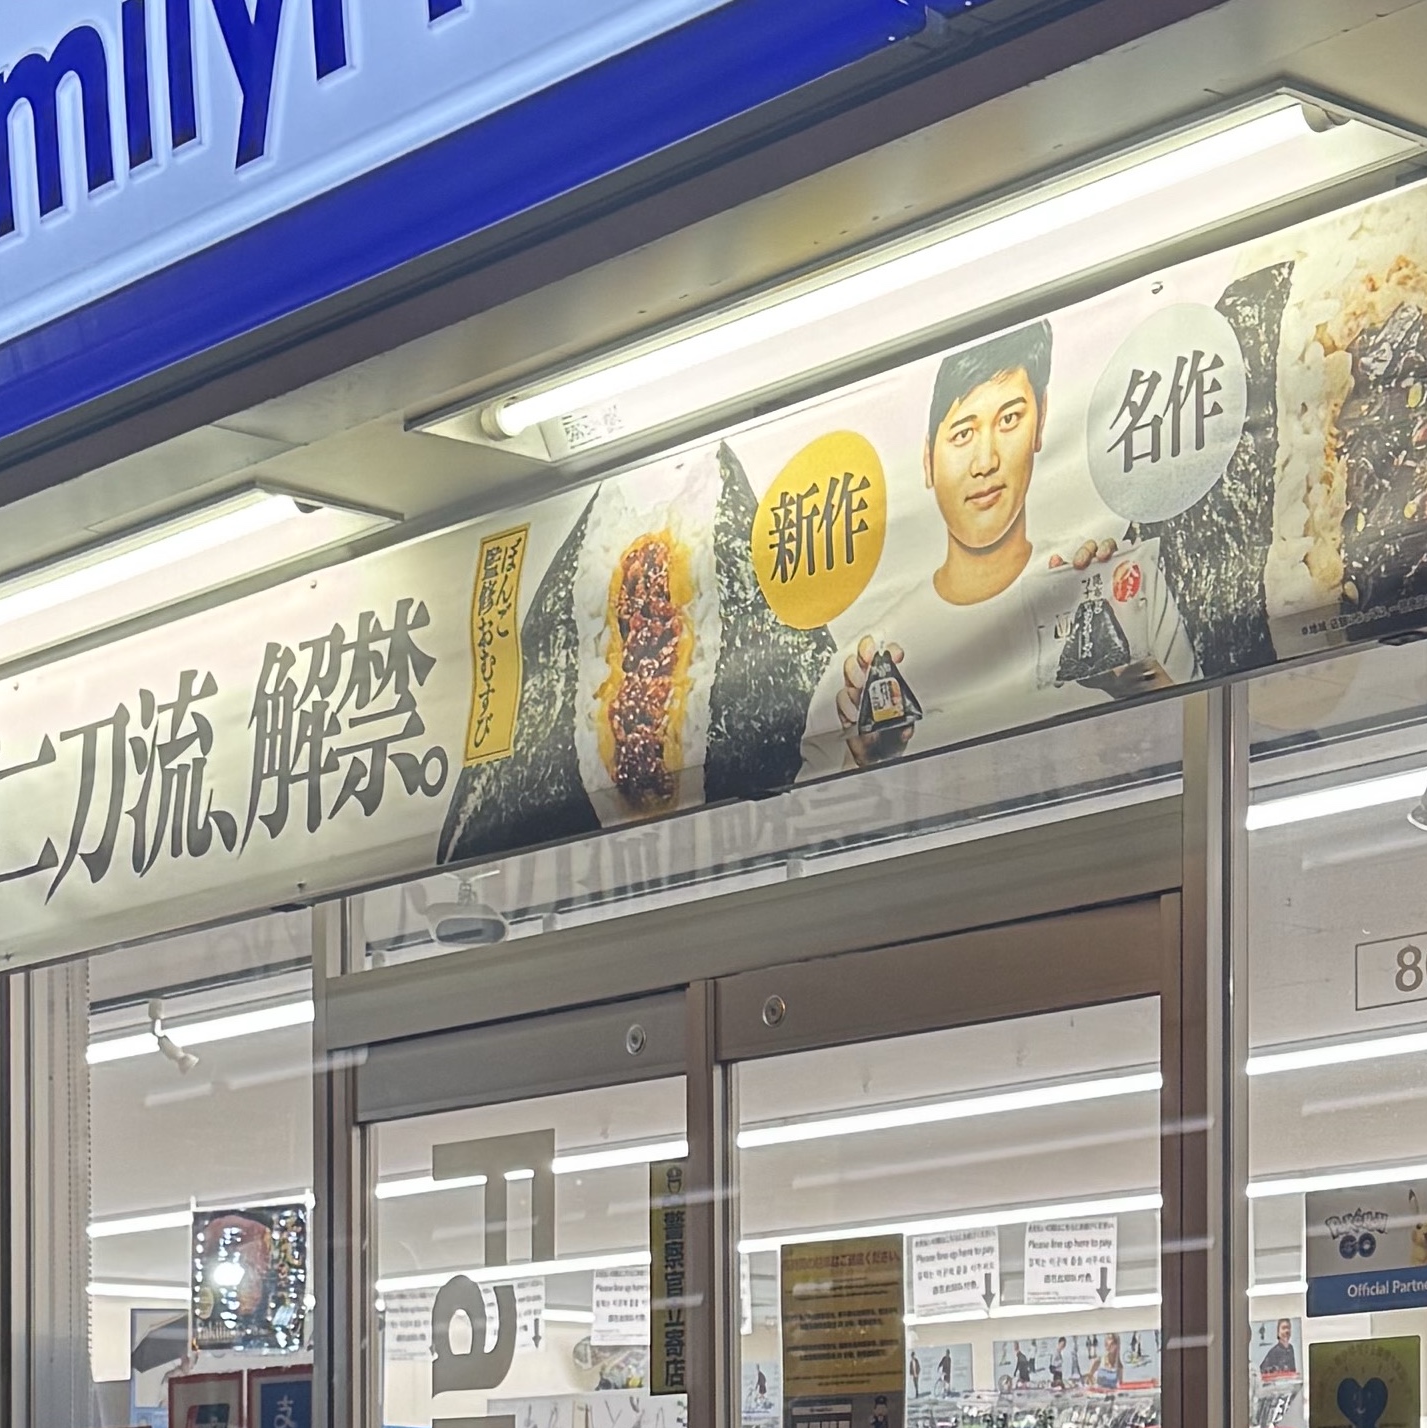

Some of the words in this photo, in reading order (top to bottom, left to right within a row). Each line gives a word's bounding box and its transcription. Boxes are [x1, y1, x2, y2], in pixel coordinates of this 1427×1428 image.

[1107, 349, 1223, 474] 名作
[769, 472, 872, 583] 新作
[474, 546, 501, 748] 監修おむすび
[1339, 1232, 1376, 1259] GO
[1347, 1281, 1389, 1298] Official
